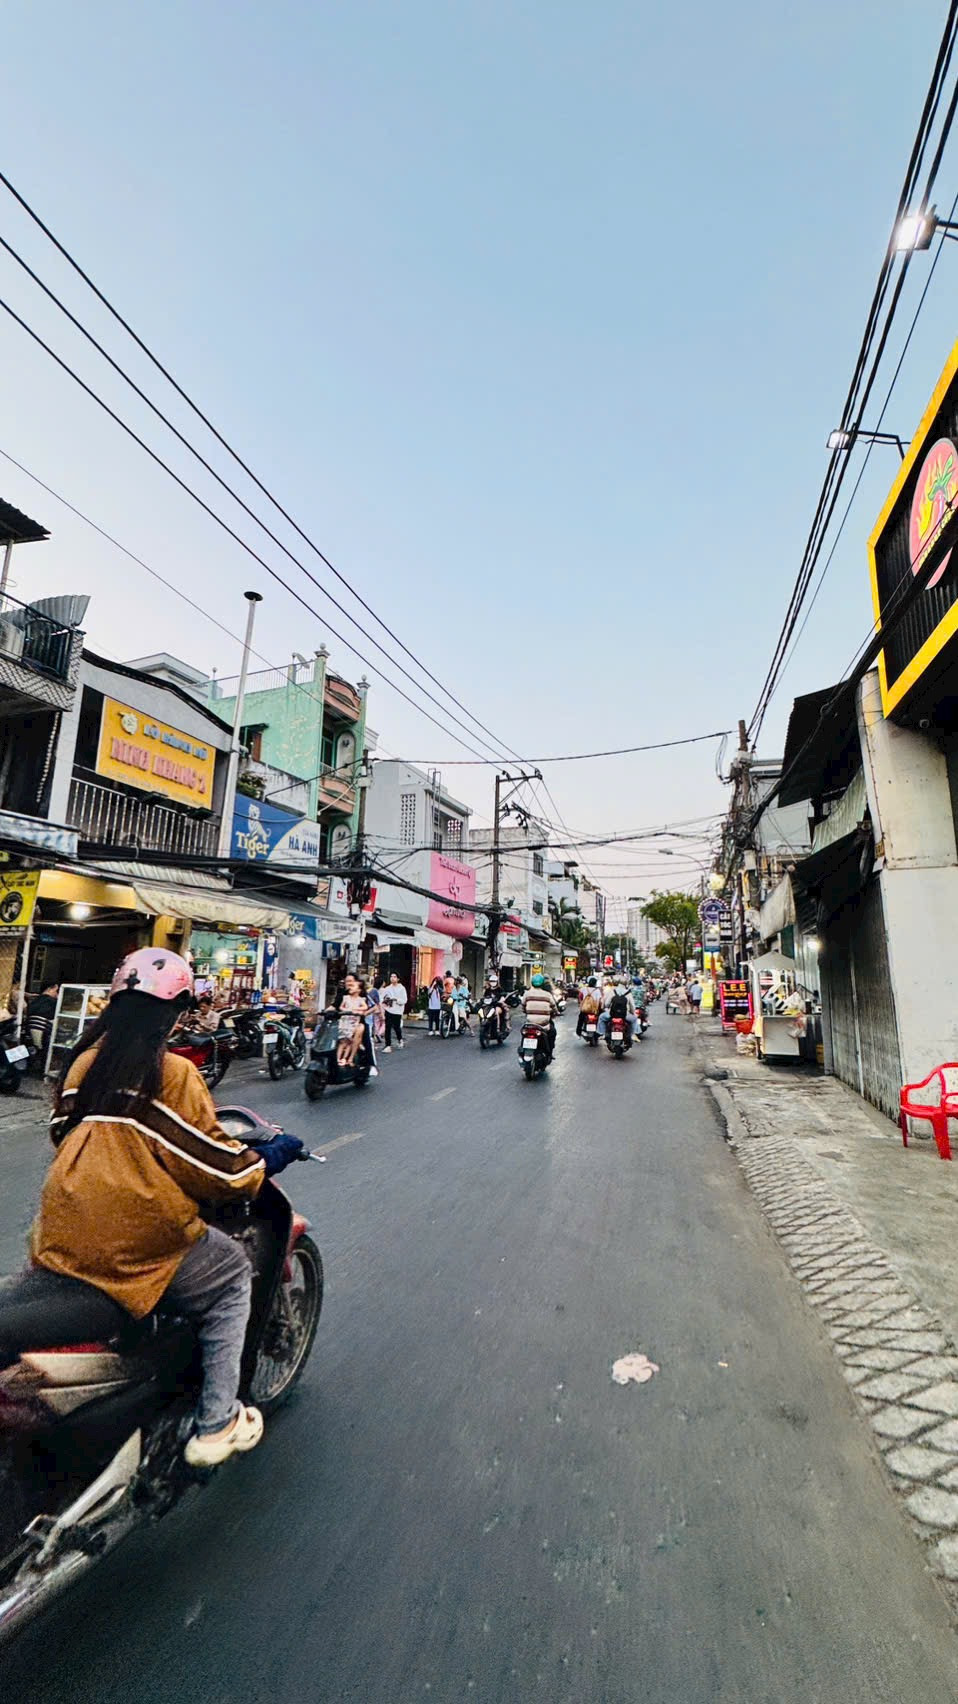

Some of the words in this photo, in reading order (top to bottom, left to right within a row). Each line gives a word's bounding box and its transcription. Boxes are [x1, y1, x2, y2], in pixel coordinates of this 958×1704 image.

[235, 830, 270, 859] Tiger
[288, 834, 300, 851] HÀ
[301, 840, 318, 857] ANH
